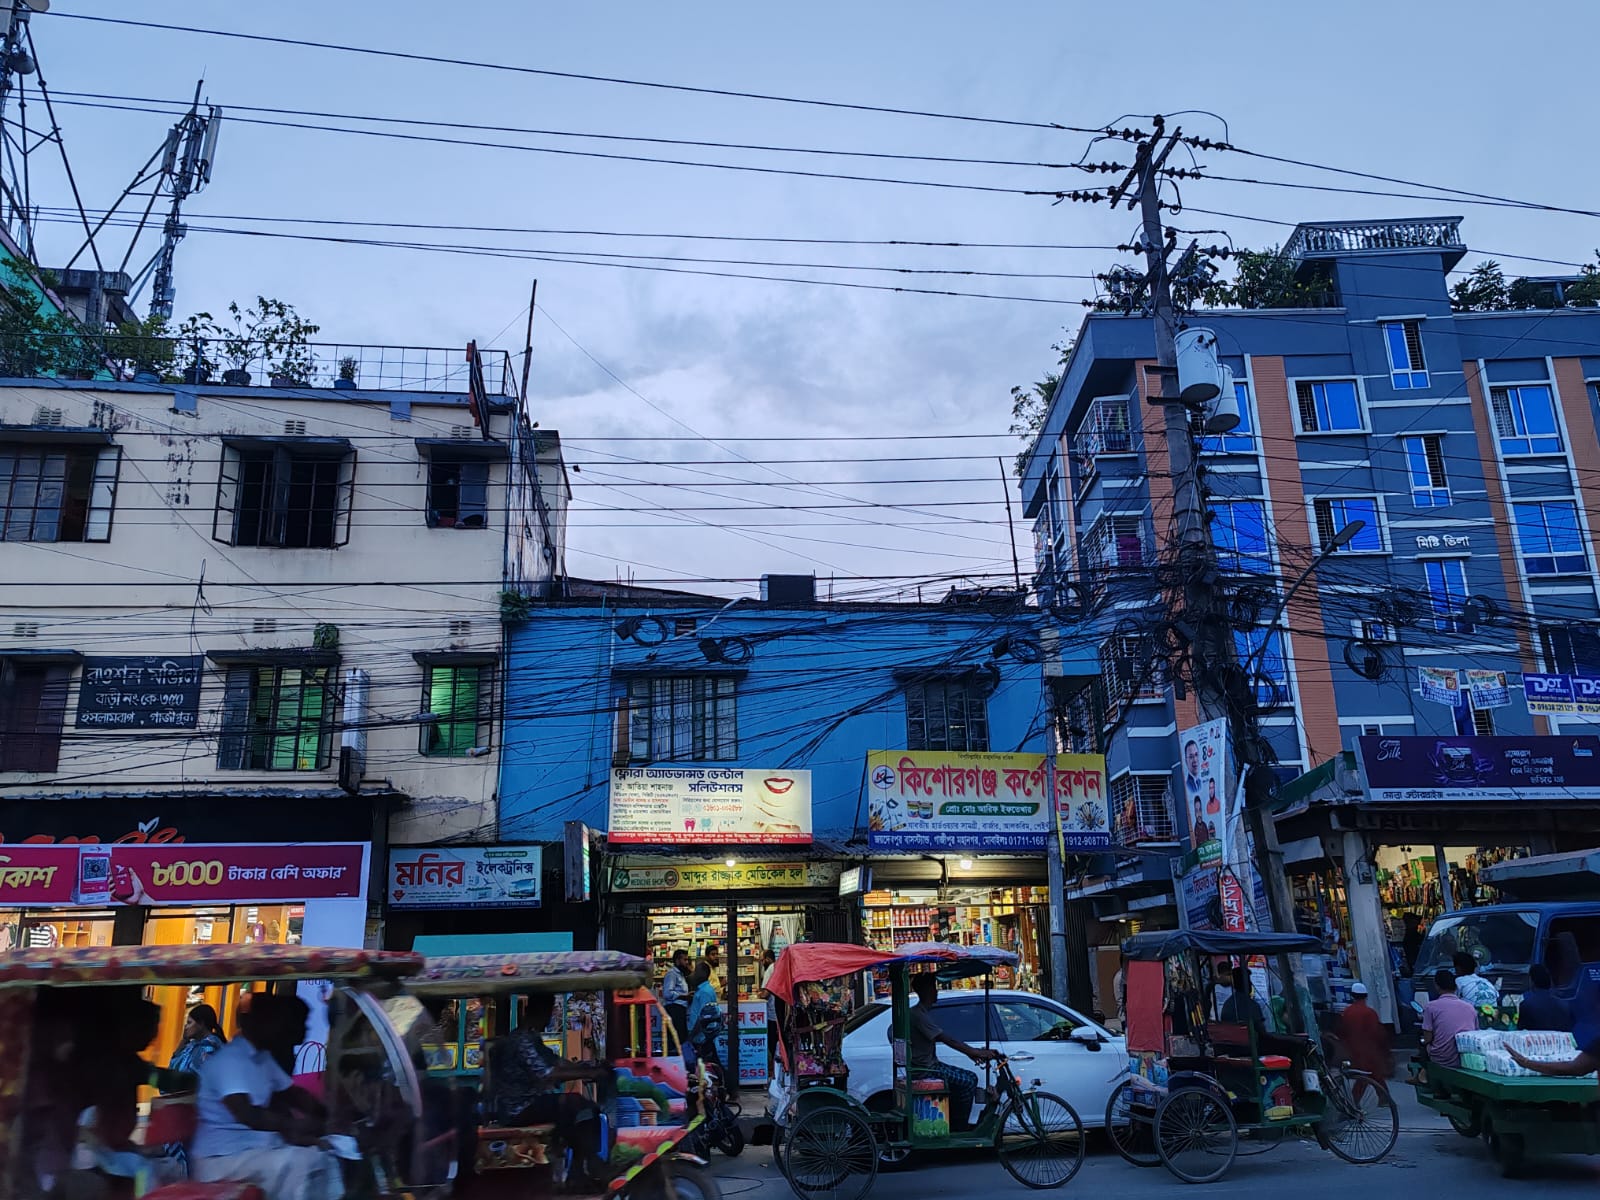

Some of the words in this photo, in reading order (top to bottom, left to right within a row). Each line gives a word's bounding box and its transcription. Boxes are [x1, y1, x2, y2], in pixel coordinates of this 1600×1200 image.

[1525, 676, 1562, 693] DOT
[1376, 739, 1403, 761] Silk
[614, 769, 644, 781] ফ্লোরা
[707, 768, 744, 780] ডেন্টাল
[897, 757, 997, 798] কিশোরগঞ্জ
[688, 781, 743, 793] সলিউশনস
[227, 865, 268, 881] টাকার
[270, 864, 300, 880] বেশি
[394, 853, 466, 888] মনির
[681, 870, 708, 885] আব্দুর
[710, 868, 743, 883] রাজ্জাক
[745, 865, 786, 882] মেডিকেল
[788, 868, 804, 880] হল
[748, 1011, 765, 1025] হল
[740, 1068, 766, 1078] 255
